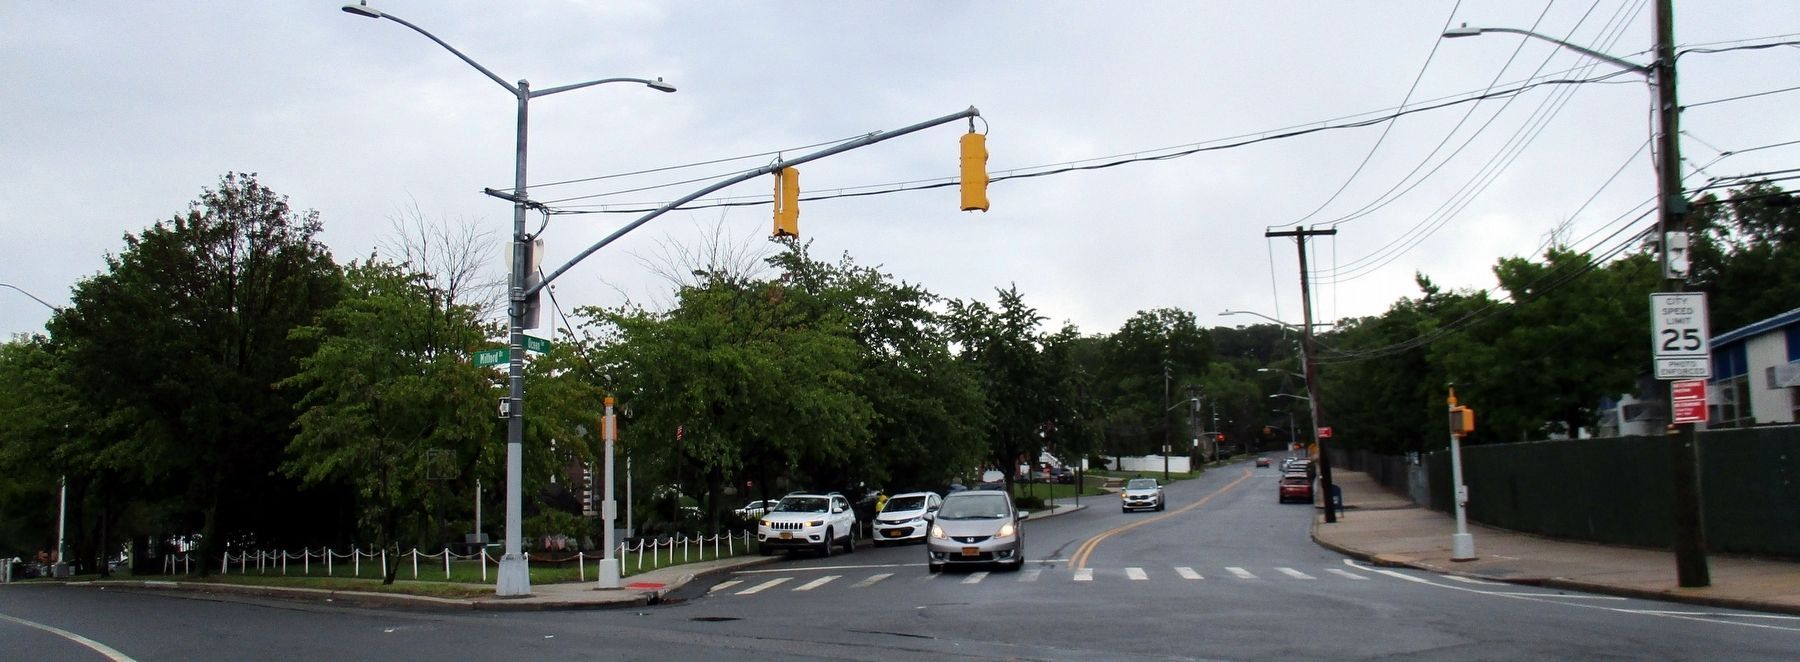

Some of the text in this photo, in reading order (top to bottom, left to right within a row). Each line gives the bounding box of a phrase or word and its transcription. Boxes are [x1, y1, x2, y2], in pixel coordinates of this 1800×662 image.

[1666, 297, 1688, 305] CITY
[1666, 317, 1691, 325] LIMIT
[1662, 328, 1701, 351] 25
[479, 352, 499, 364] Milford
[1661, 367, 1705, 375] ENFORCED
